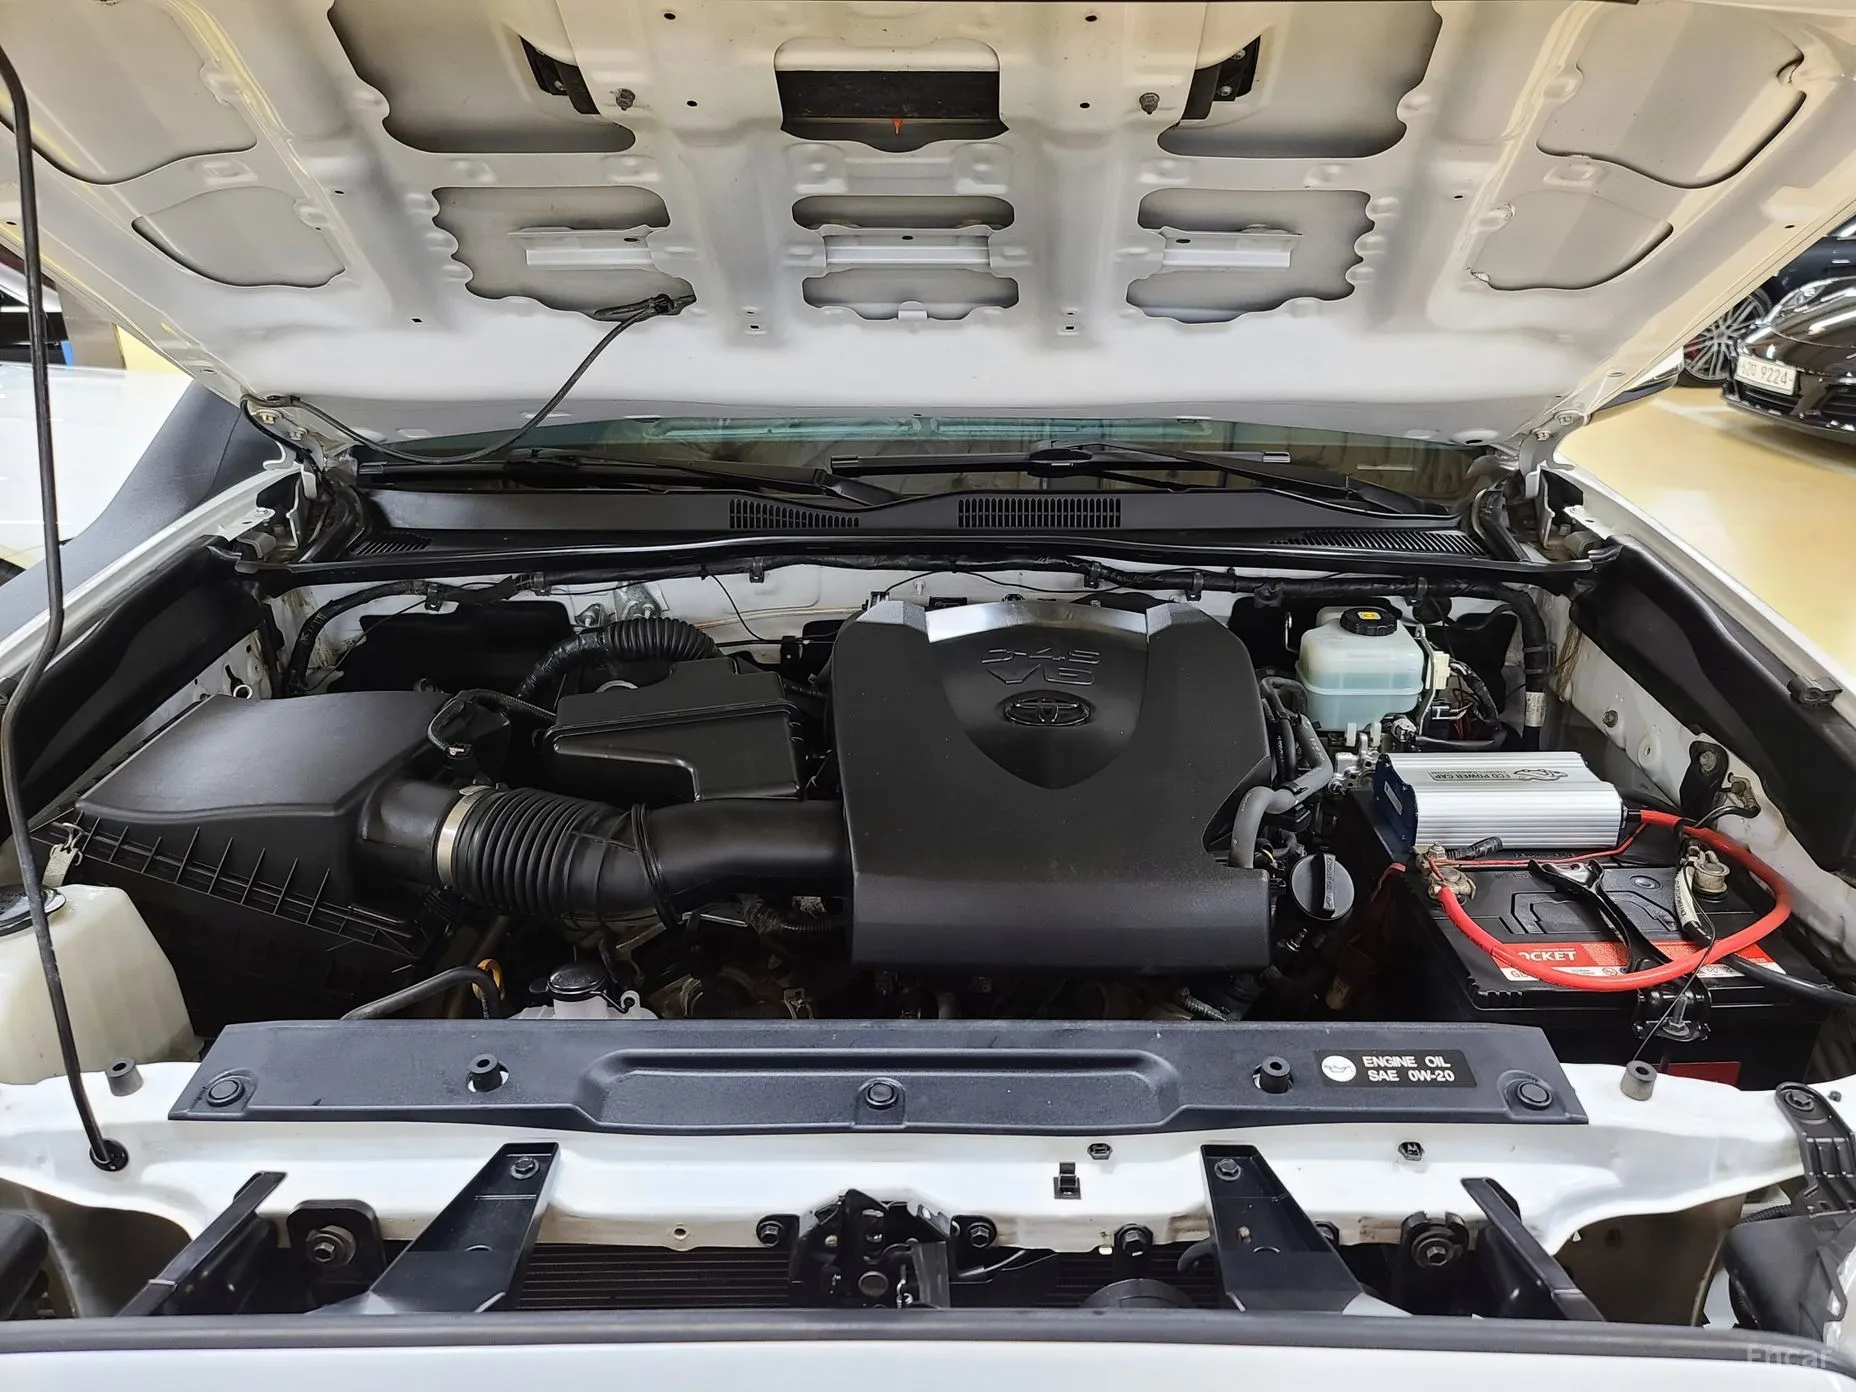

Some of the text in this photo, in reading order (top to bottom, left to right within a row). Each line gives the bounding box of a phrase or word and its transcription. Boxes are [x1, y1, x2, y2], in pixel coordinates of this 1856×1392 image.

[1517, 951, 1577, 962] OCKET
[1362, 1056, 1451, 1068] ENGINE OIL
[1368, 1070, 1455, 1082] SAE 0W-20
